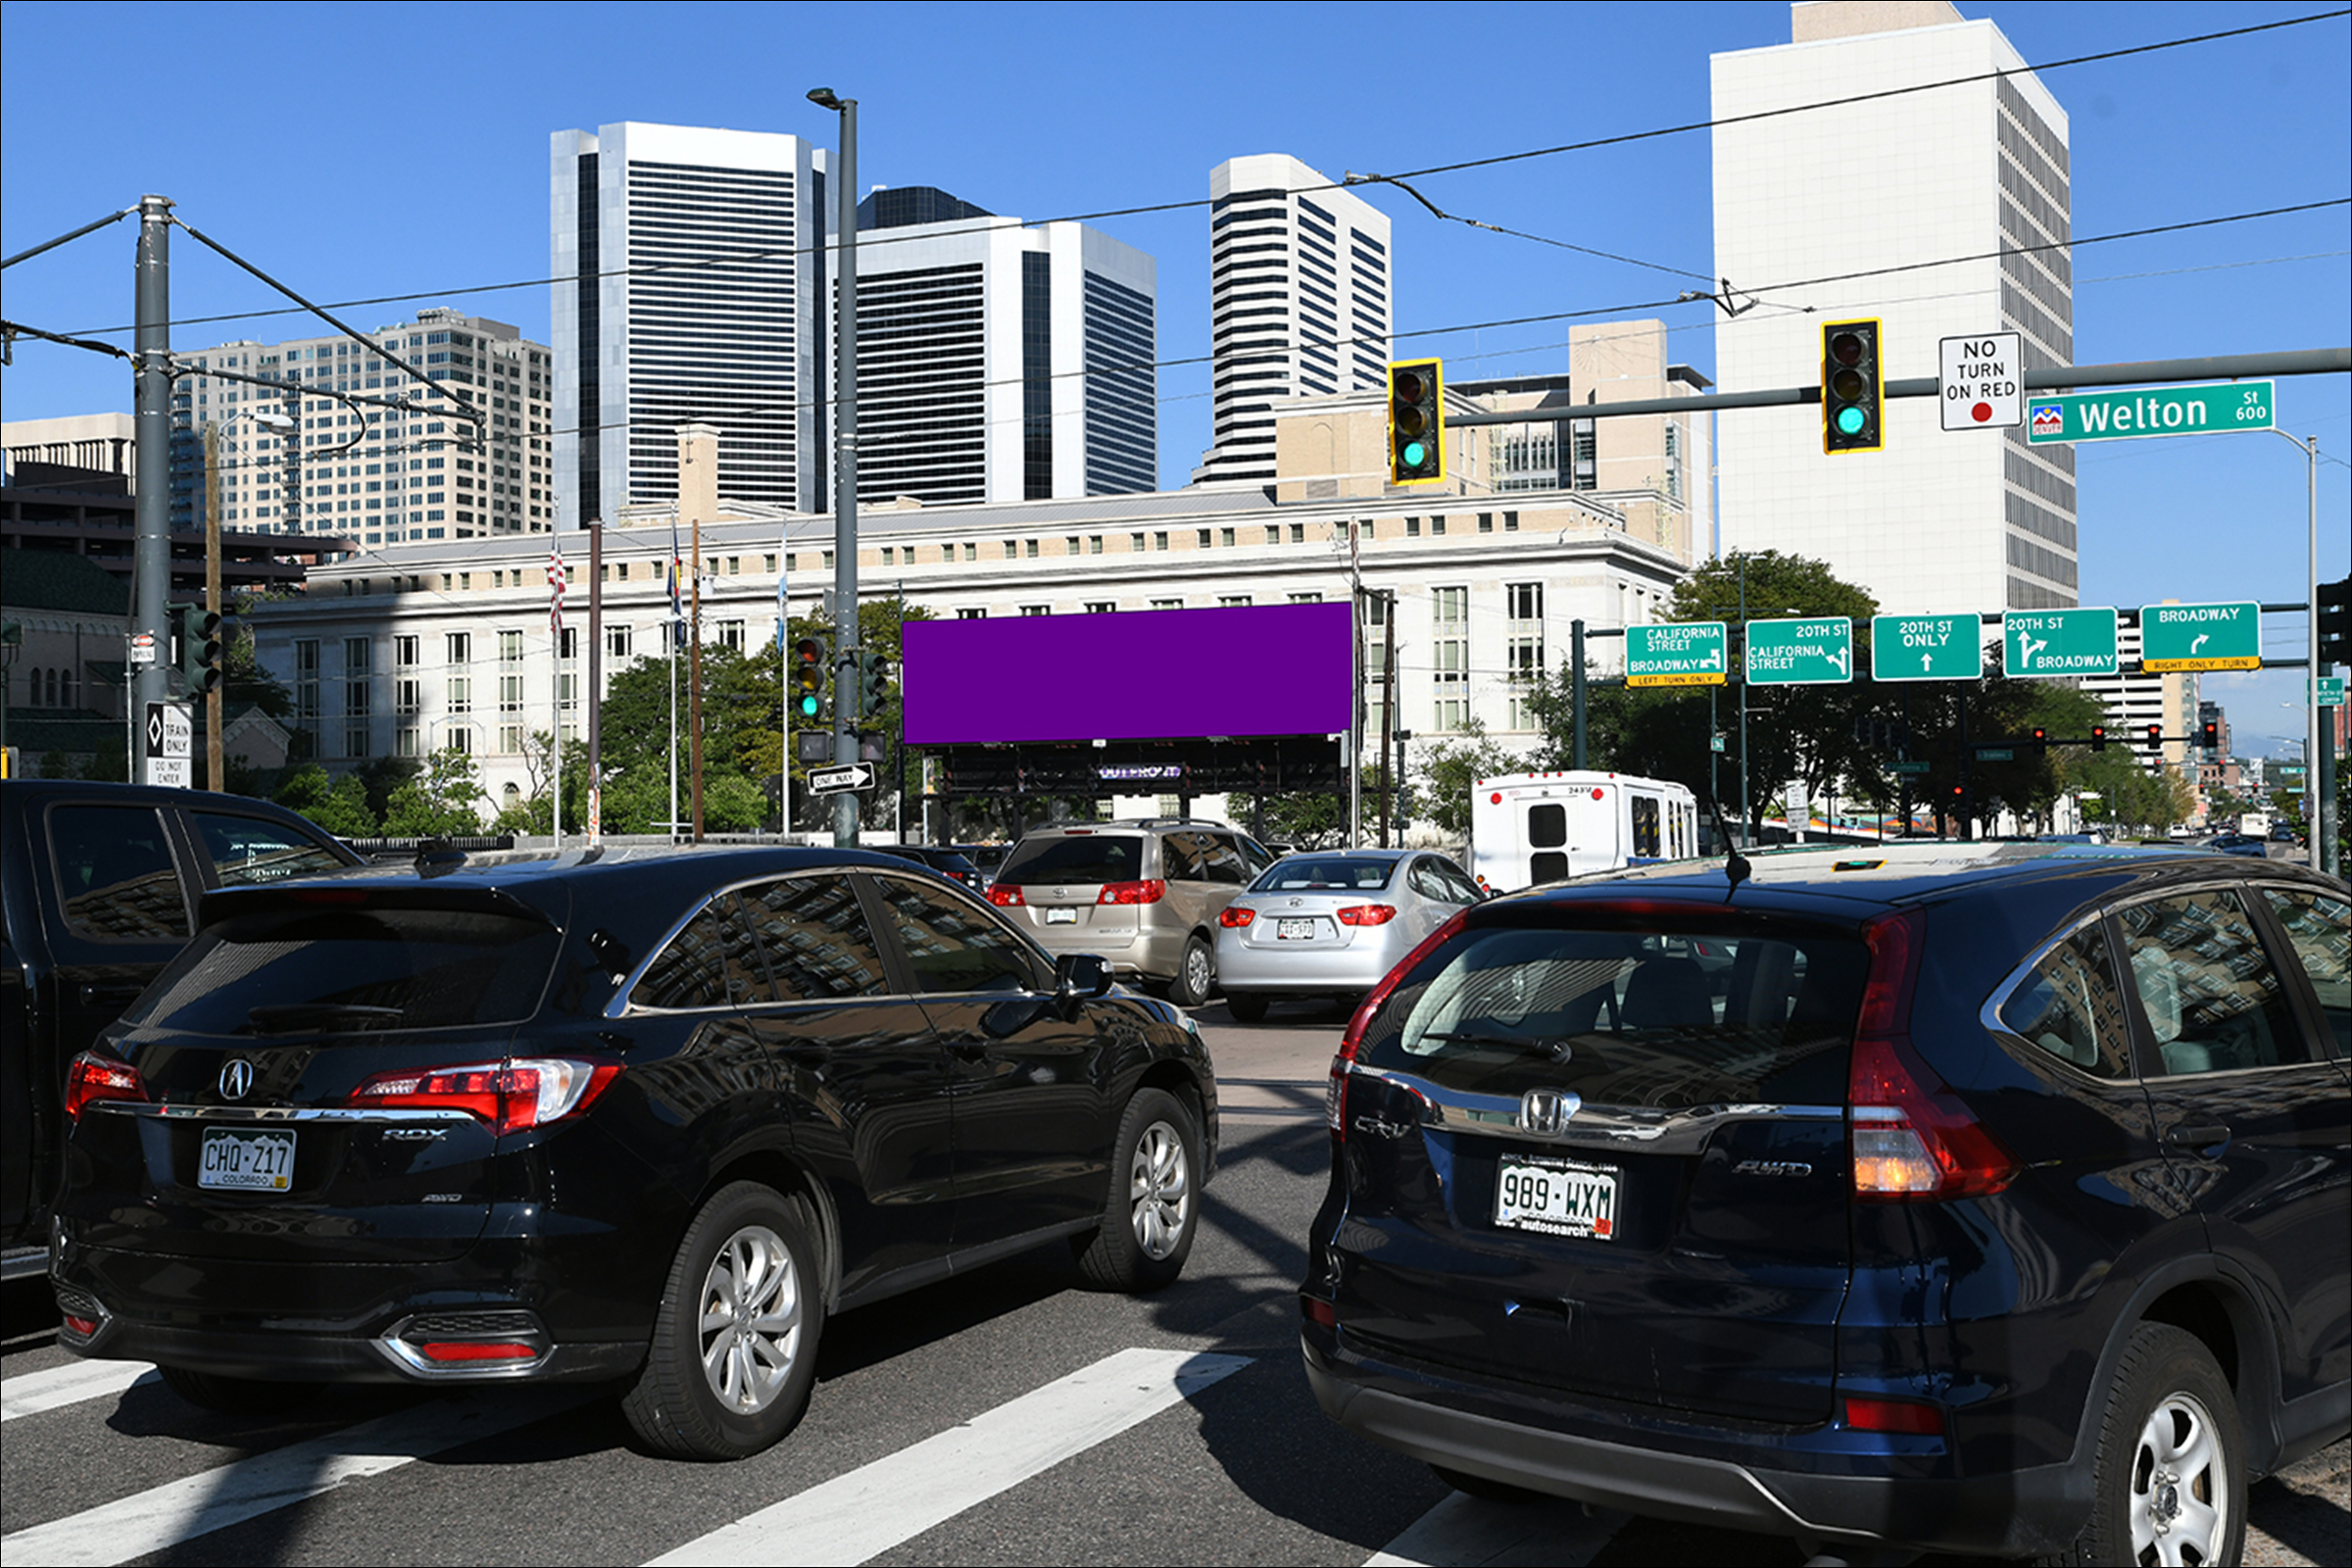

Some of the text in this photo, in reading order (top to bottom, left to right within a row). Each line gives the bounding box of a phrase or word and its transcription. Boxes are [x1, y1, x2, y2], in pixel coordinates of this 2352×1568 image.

[1964, 340, 1996, 359] NO
[1957, 362, 2004, 379] TURN
[1946, 381, 2016, 401] ON RED
[2243, 390, 2259, 405] St
[2079, 397, 2207, 433] Welton
[2235, 406, 2267, 421] 600
[2159, 607, 2240, 622] BROADWAY
[1796, 623, 1848, 638] 20TH ST
[1899, 619, 1953, 634] 20TH ST
[2007, 616, 2064, 631] 20TH ST
[1646, 626, 1721, 641] CALIFORNIA
[1902, 633, 1950, 648] ONLY
[1647, 639, 1691, 653] STREET
[1748, 645, 1826, 659] CALIFORNIA
[1630, 658, 1699, 673] BROADWAY
[1749, 657, 1794, 670] STREET
[2036, 655, 2114, 669] BROADWAY
[2154, 659, 2249, 670] RIGHT ONLY TURN
[1639, 676, 1658, 685] LEFT
[1690, 675, 1714, 684] ONLY
[166, 723, 189, 737] TRAIN
[166, 739, 188, 753] ONLY
[155, 760, 182, 772] DO NOT
[157, 773, 180, 784] ENTER
[815, 773, 854, 787] ONE WAY
[382, 1128, 450, 1141] RDX
[1732, 1160, 1812, 1177] AWD
[222, 1174, 269, 1186] COLORADO
[421, 1194, 463, 1203] AWD
[1520, 1219, 1589, 1238] autosearch
